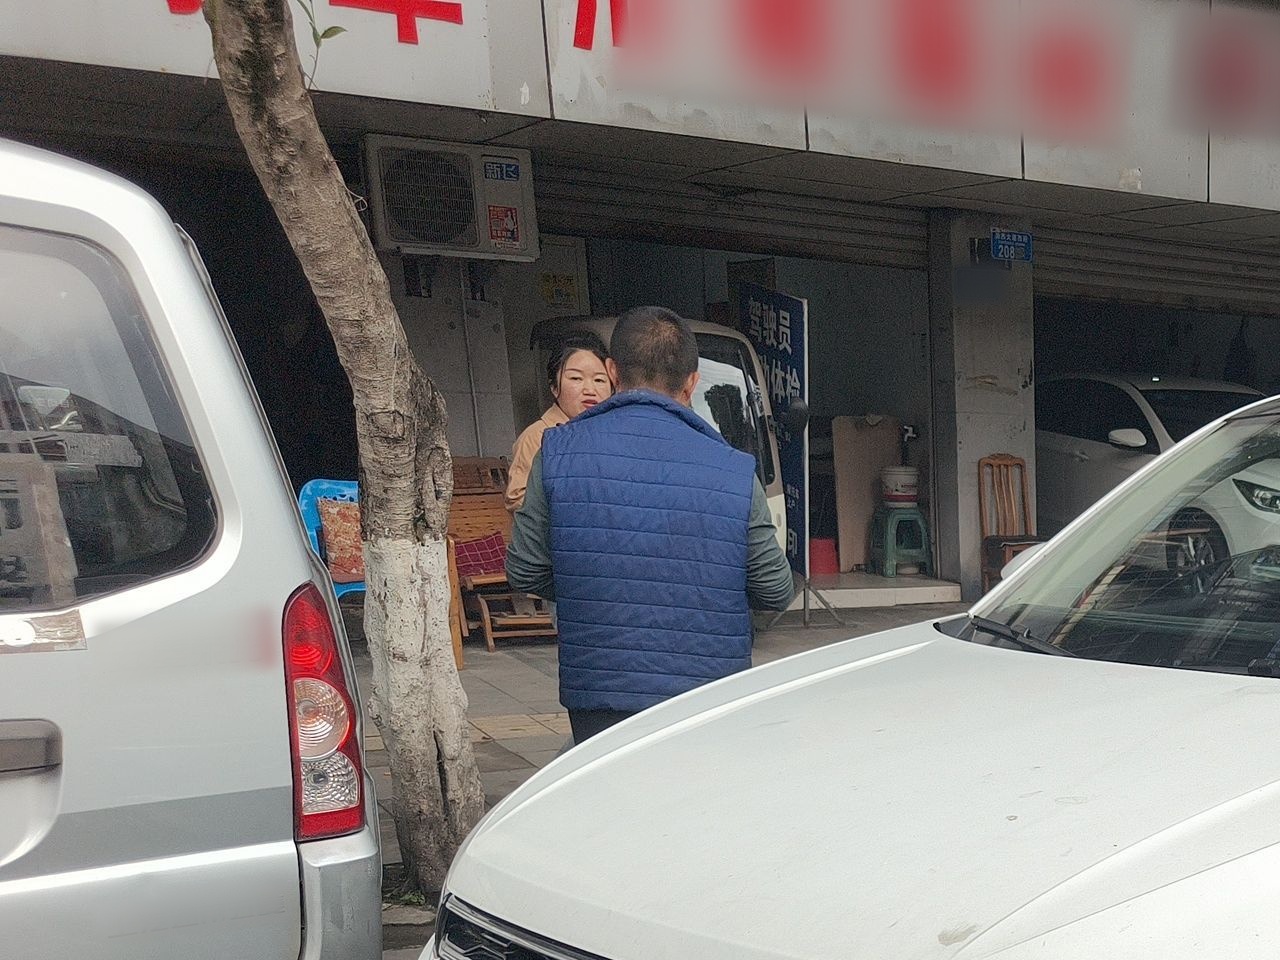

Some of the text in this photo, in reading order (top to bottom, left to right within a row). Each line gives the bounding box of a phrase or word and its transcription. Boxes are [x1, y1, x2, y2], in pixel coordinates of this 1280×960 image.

[998, 245, 1015, 259] 208
[749, 297, 792, 356] 驾驶员
